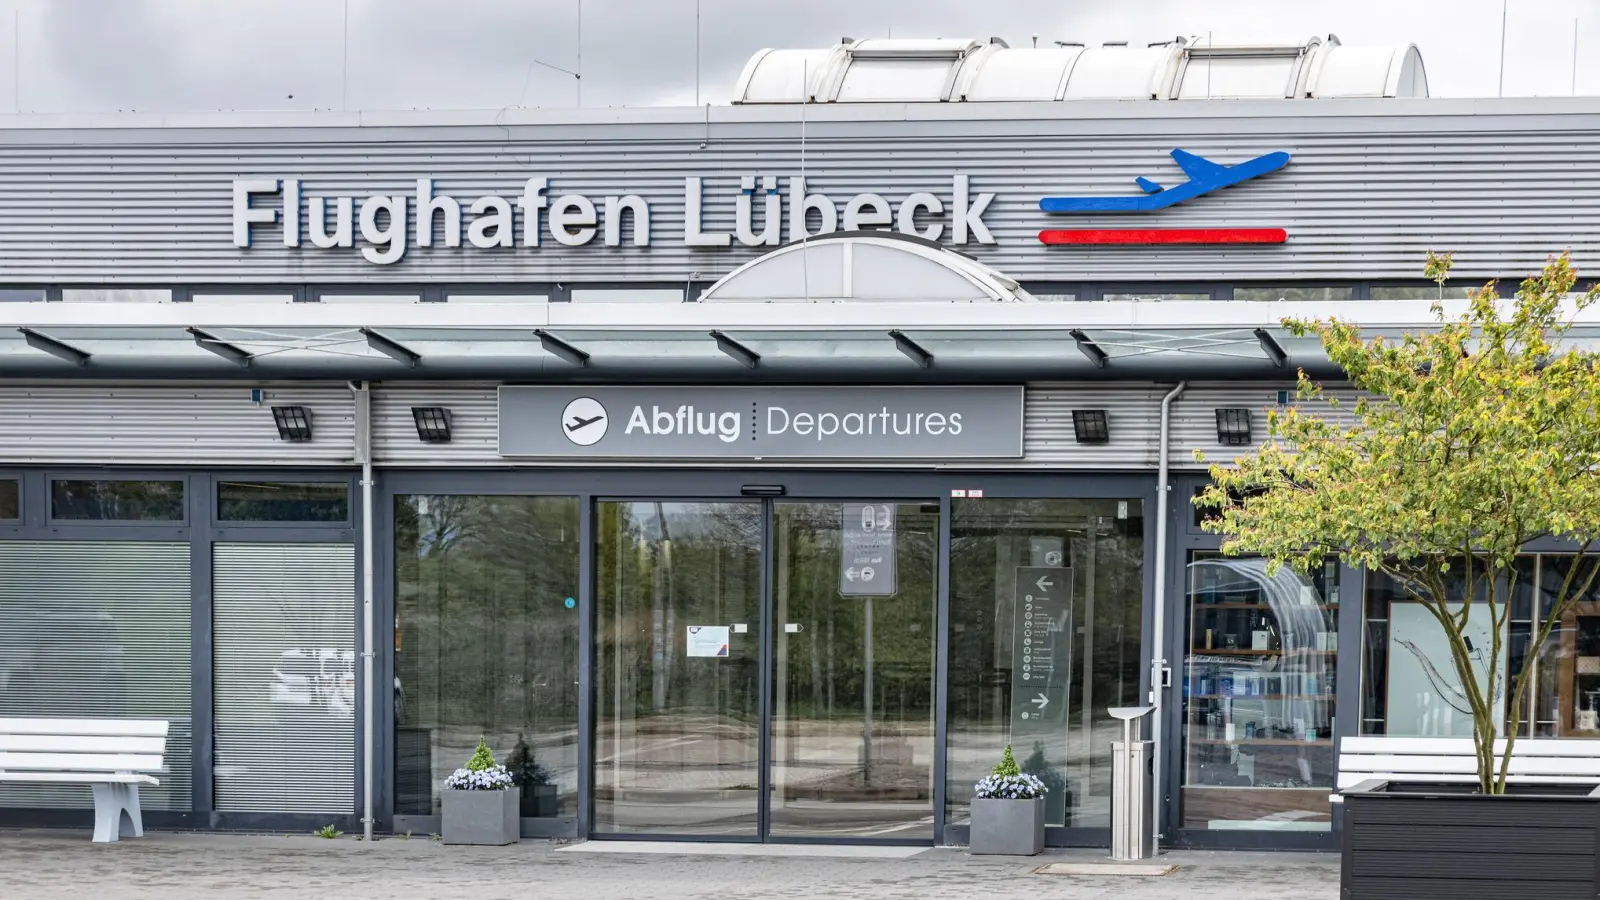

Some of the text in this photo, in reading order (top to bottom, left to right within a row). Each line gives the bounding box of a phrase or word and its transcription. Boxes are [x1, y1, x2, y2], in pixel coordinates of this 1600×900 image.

[232, 174, 998, 265] Flughafen Lübeck
[624, 405, 741, 443] Abflug
[766, 406, 963, 442] Departures
